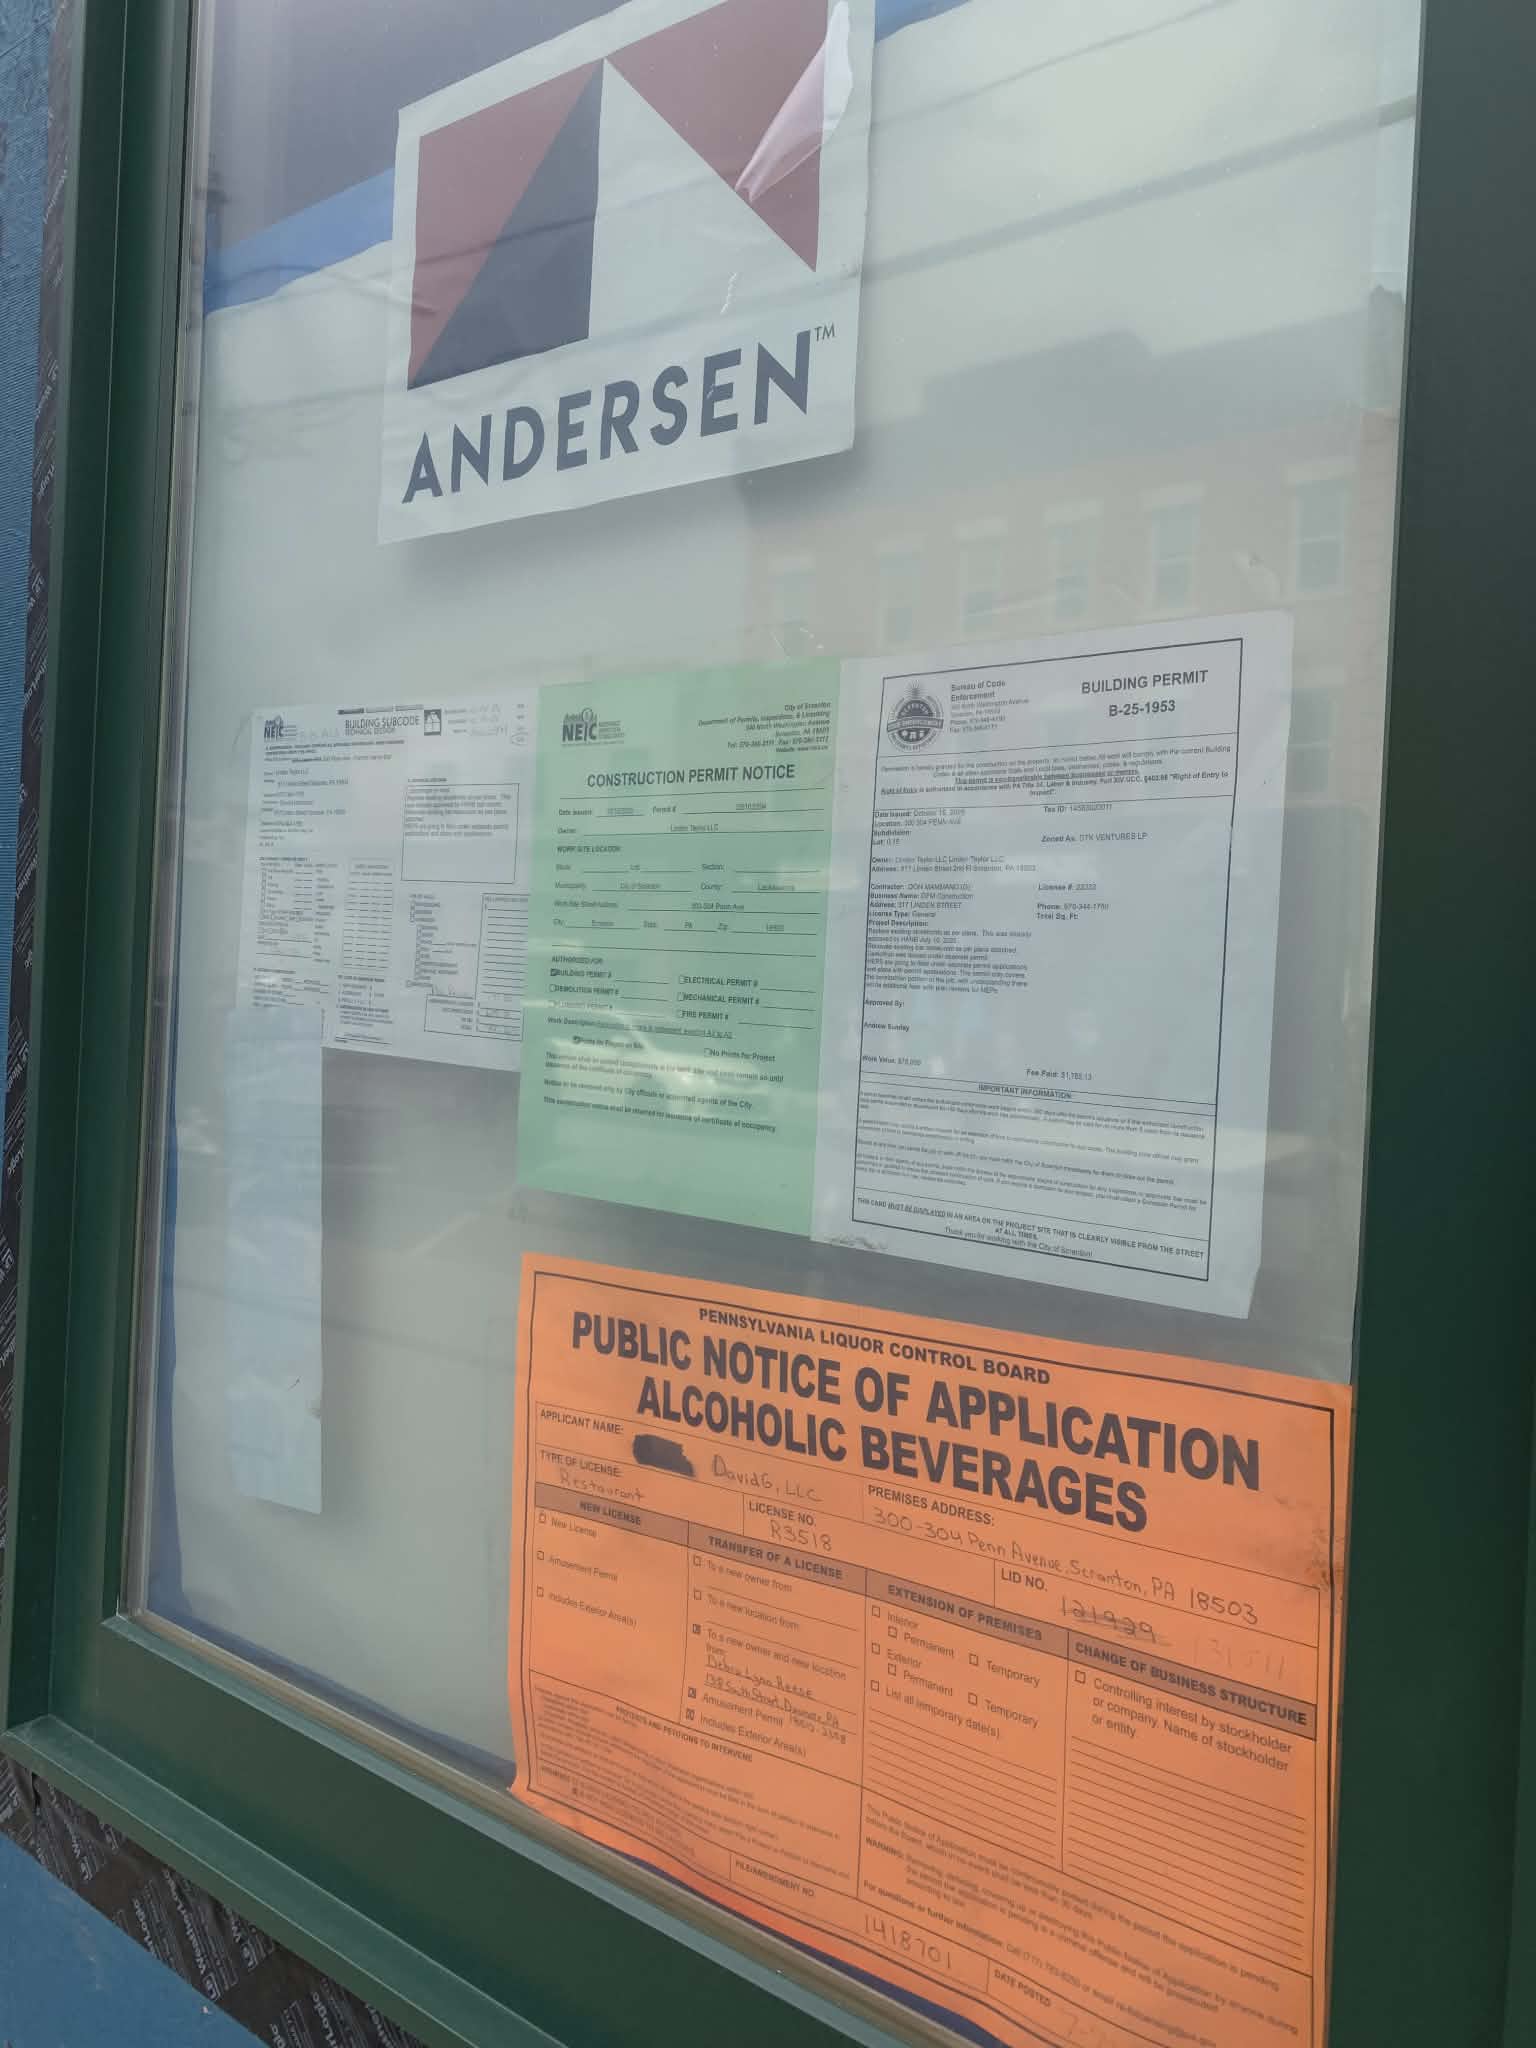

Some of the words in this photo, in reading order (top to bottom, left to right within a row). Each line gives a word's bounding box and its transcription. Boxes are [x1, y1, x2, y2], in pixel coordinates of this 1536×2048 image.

[402, 329, 812, 505] ANDERSEN
[986, 680, 1006, 688] Code
[1081, 676, 1148, 694] BUILDING
[1152, 669, 1208, 688] PERMIT
[1109, 699, 1176, 717] B-25-1953
[587, 770, 685, 788] CONSTRUCTION
[688, 767, 738, 784] PERMIT
[743, 764, 796, 781] NOTICE
[1202, 772, 1219, 780] Entry
[685, 976, 725, 986] ELECTRICAL
[726, 978, 752, 987] PERMIT
[683, 993, 726, 1003] MECHANICAL
[728, 996, 754, 1005] PERMIT
[698, 1011, 723, 1020] PERMIT
[978, 1083, 1020, 1096] IMPORTANT
[1021, 1087, 1072, 1100] INFORMATION
[964, 1214, 981, 1223] AREA
[1052, 1228, 1068, 1237] THAT
[1078, 1232, 1109, 1244] CLEARLY
[1110, 1238, 1136, 1248] VISIBLE
[1137, 1241, 1158, 1251] FROM
[1160, 1245, 1174, 1254] THE
[1175, 1247, 1204, 1259] STREET
[1004, 1228, 1016, 1237] ALL
[700, 1307, 815, 1342] PENNSYLVANIA
[821, 1329, 884, 1354] LIQUOR
[890, 1342, 977, 1372] CONTROL
[983, 1358, 1050, 1385] BOARD
[572, 1311, 691, 1371] PUBLIC
[703, 1335, 841, 1405] NOTICE
[854, 1366, 910, 1417] OF
[926, 1380, 1260, 1491] APPLICATION
[541, 1409, 590, 1429] APPLICANT
[540, 1449, 564, 1464] TYPE
[565, 1456, 577, 1467] OF
[637, 1375, 847, 1462] ALCOHOLIC
[860, 1424, 1148, 1532] BEVERAGES
[580, 1501, 601, 1513] NEW
[602, 1507, 641, 1526] LICENSE
[748, 1500, 795, 1521] LICENSE
[797, 1513, 817, 1527] NO.
[868, 1484, 928, 1509] PREMISES
[931, 1501, 995, 1527] ADDRESS:
[551, 1517, 568, 1529] New
[708, 1535, 763, 1560] TRANSFER
[766, 1551, 781, 1561] OF
[783, 1555, 792, 1565] A
[794, 1559, 843, 1580] LICENSE
[873, 1507, 963, 1545] 300-304
[967, 1530, 1007, 1558] Penn
[1151, 1576, 1175, 1601] PA
[1189, 1587, 1258, 1625] 18503
[1001, 1568, 1022, 1584] LID
[1025, 1575, 1048, 1592] NO.
[888, 1584, 955, 1615] EXTENSION
[958, 1607, 976, 1620] OF
[978, 1613, 1043, 1641] PREMISES
[887, 1649, 923, 1668] Exterior
[904, 1632, 955, 1659] Permanent
[986, 1660, 1041, 1688] Temporary
[1075, 1641, 1127, 1668] CHANGE
[1129, 1659, 1148, 1674] OF
[1150, 1663, 1217, 1698] BUSINESS
[1219, 1688, 1308, 1727] STRUCTURE
[903, 1670, 954, 1697] Permanent
[984, 1699, 1039, 1728] Temporary
[1091, 1714, 1104, 1725] or
[1106, 1717, 1137, 1739] entity
[1093, 1677, 1153, 1709] Controlling
[1155, 1700, 1199, 1724] interest
[1201, 1714, 1216, 1731] by
[1216, 1721, 1292, 1753] stockholder
[699, 1738, 711, 1749] TO
[1092, 1697, 1104, 1708] or
[1163, 1719, 1199, 1742] Name
[1201, 1734, 1214, 1746] of
[1215, 1737, 1290, 1771] stockholder
[864, 1913, 951, 1969] 1418701
[994, 1968, 1016, 1989] DATE
[1017, 1981, 1051, 2008] POSTED
